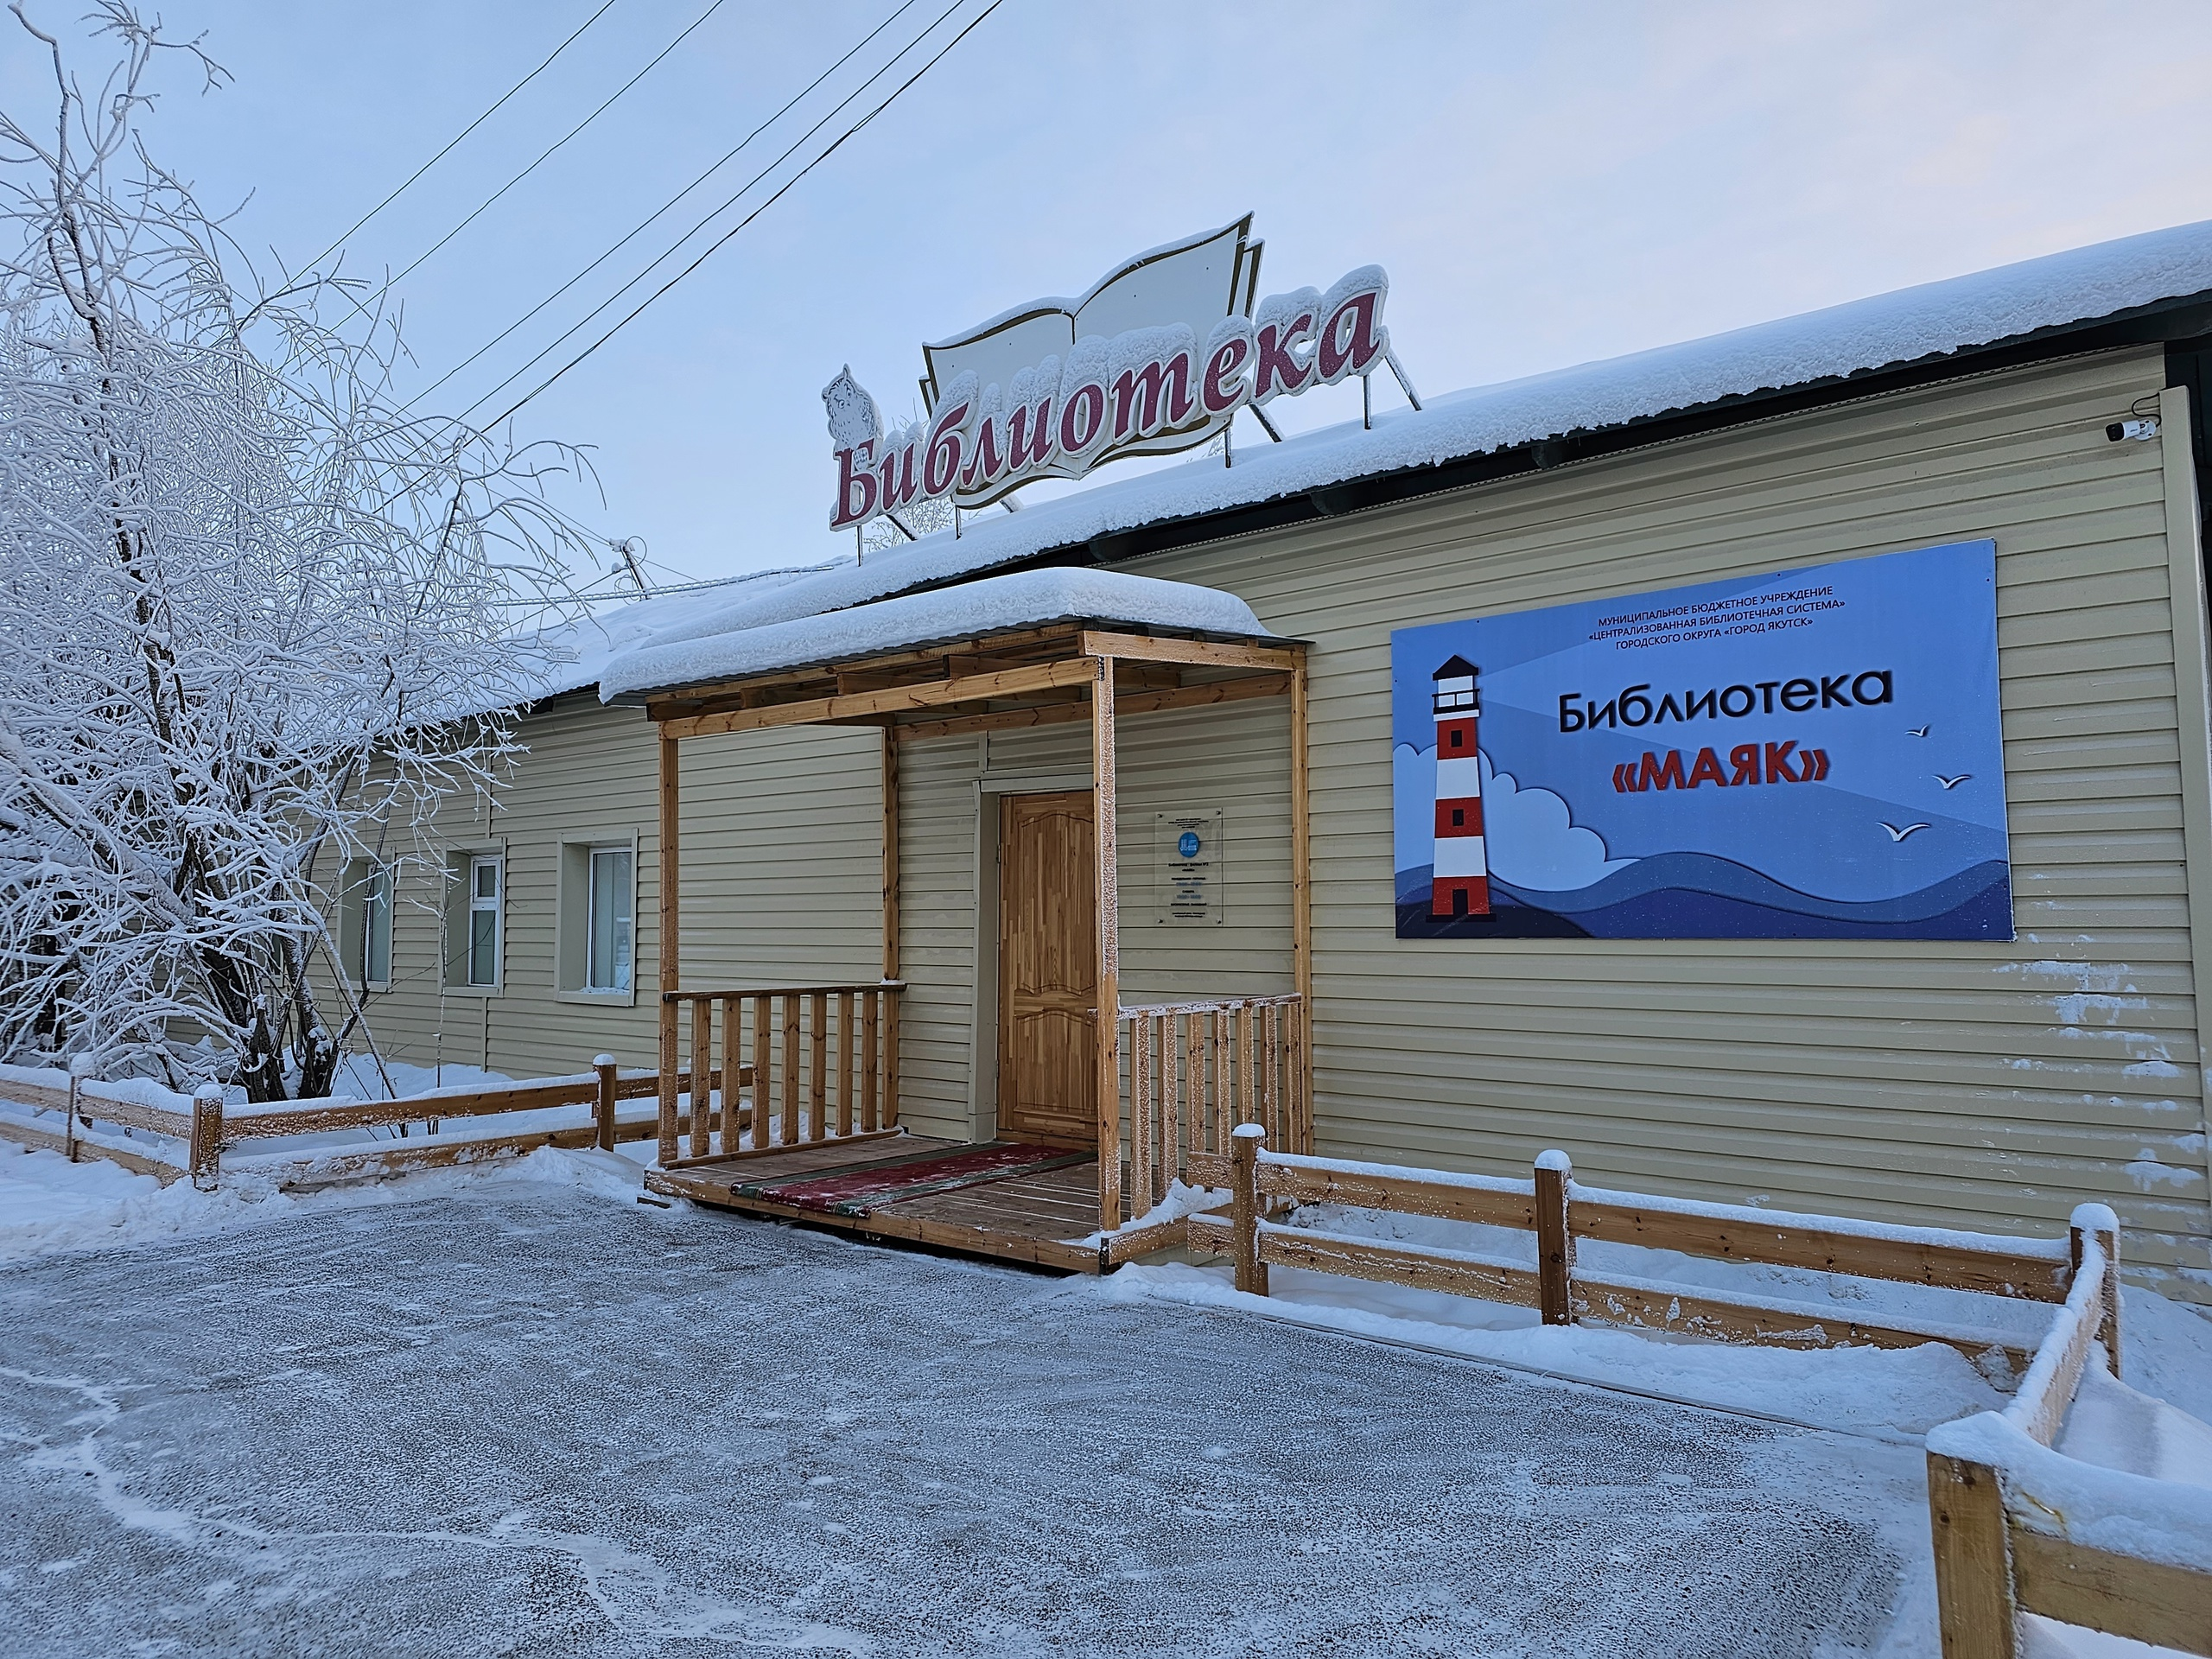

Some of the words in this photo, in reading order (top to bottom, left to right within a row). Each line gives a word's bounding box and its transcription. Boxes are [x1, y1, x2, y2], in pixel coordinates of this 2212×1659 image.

[830, 290, 1380, 529] Библиотека
[1588, 617, 1697, 641] «ЦЕНТРАЛИЗОВАННАЯ
[1699, 606, 1783, 626] БИБЛИОТЕЧНАЯ
[1785, 599, 1846, 616] СИСТЕМА»
[1598, 606, 1689, 627] МУНИЦИПАЛЬНОЕ
[1690, 595, 1758, 615] БЮДЖЕТНОЕ
[1760, 585, 1834, 605] УЧРЕЖДЕНИЕ
[1615, 632, 1681, 651] ГОРОДСКОГО
[1682, 628, 1722, 645] ОКРУГА
[1724, 621, 1765, 637] «ГОРОД
[1768, 617, 1814, 632] ЯКУТСК»
[1558, 669, 1894, 733] Библиотека
[1611, 740, 1831, 793] «МАЯК»
